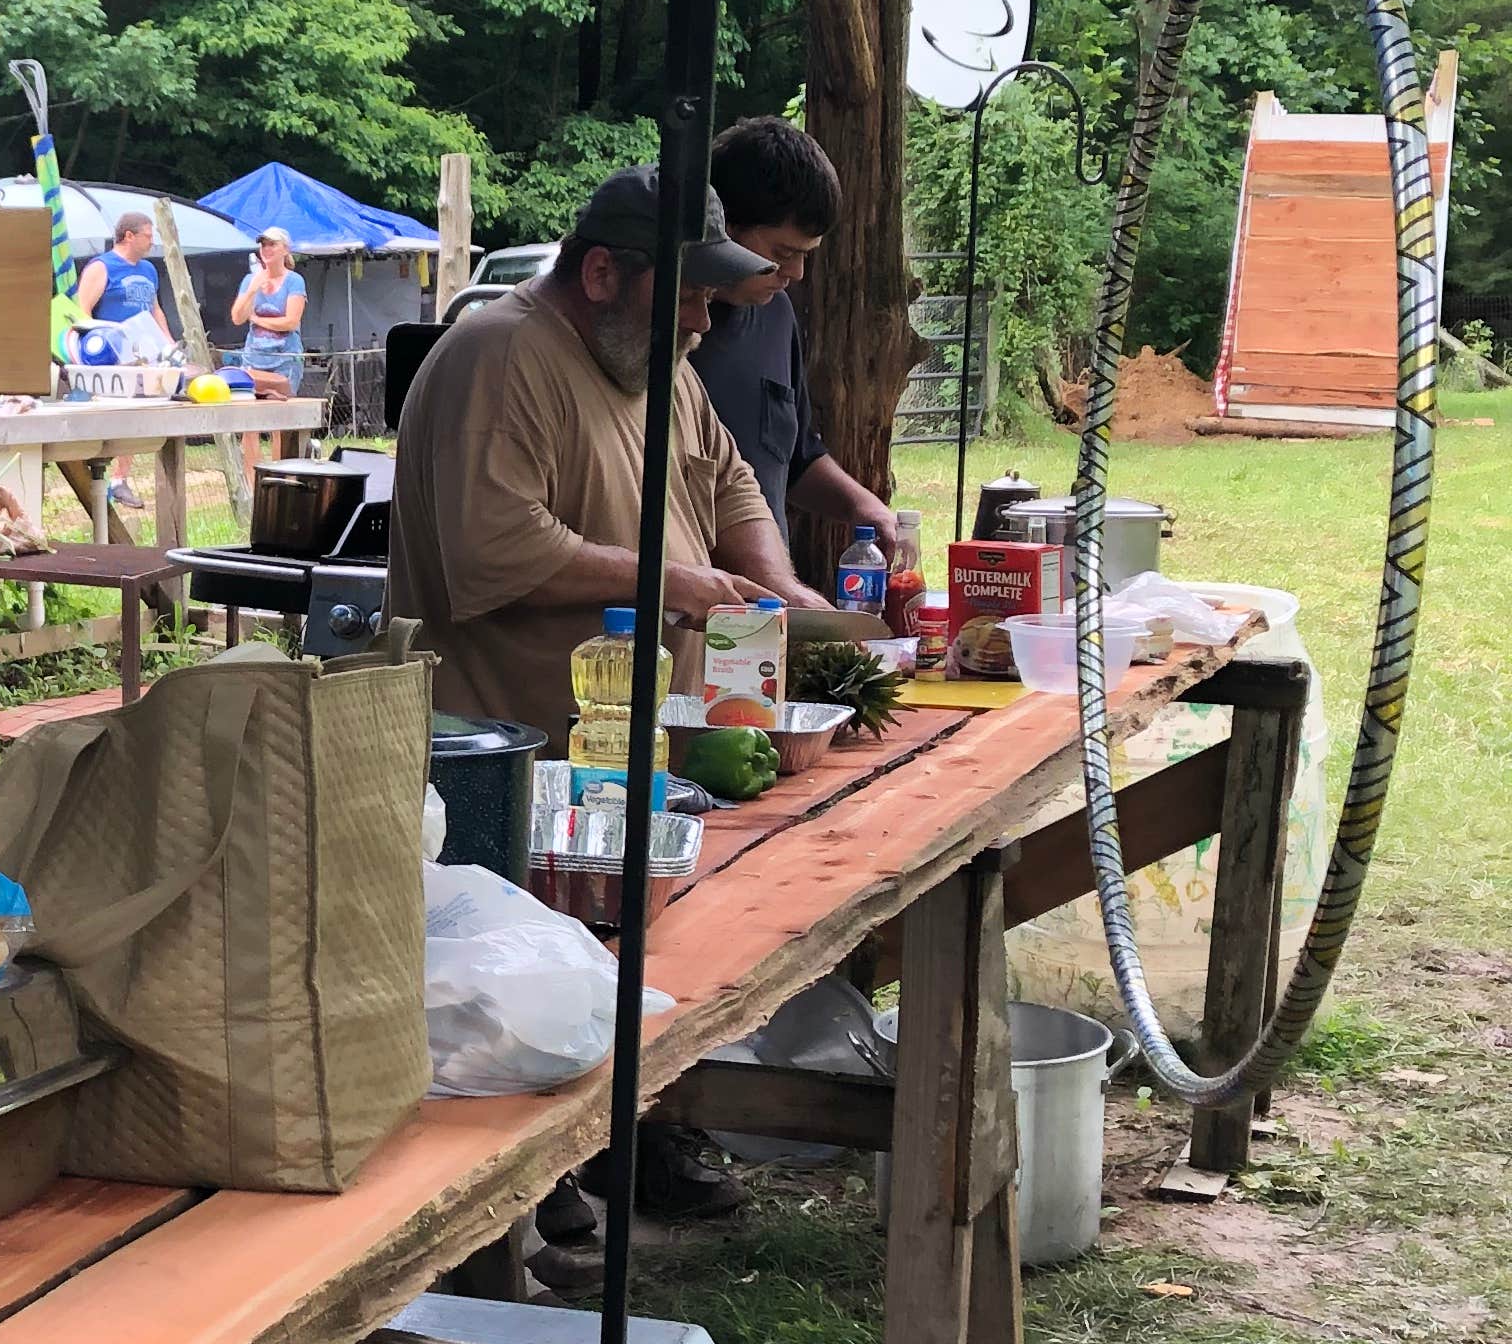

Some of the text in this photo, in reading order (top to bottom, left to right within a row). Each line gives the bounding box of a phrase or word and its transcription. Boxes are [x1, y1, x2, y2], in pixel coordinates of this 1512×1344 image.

[954, 567, 1032, 588] BUTTERMILK
[963, 584, 1023, 601] COMPLETE
[586, 794, 626, 805] Vegetable
